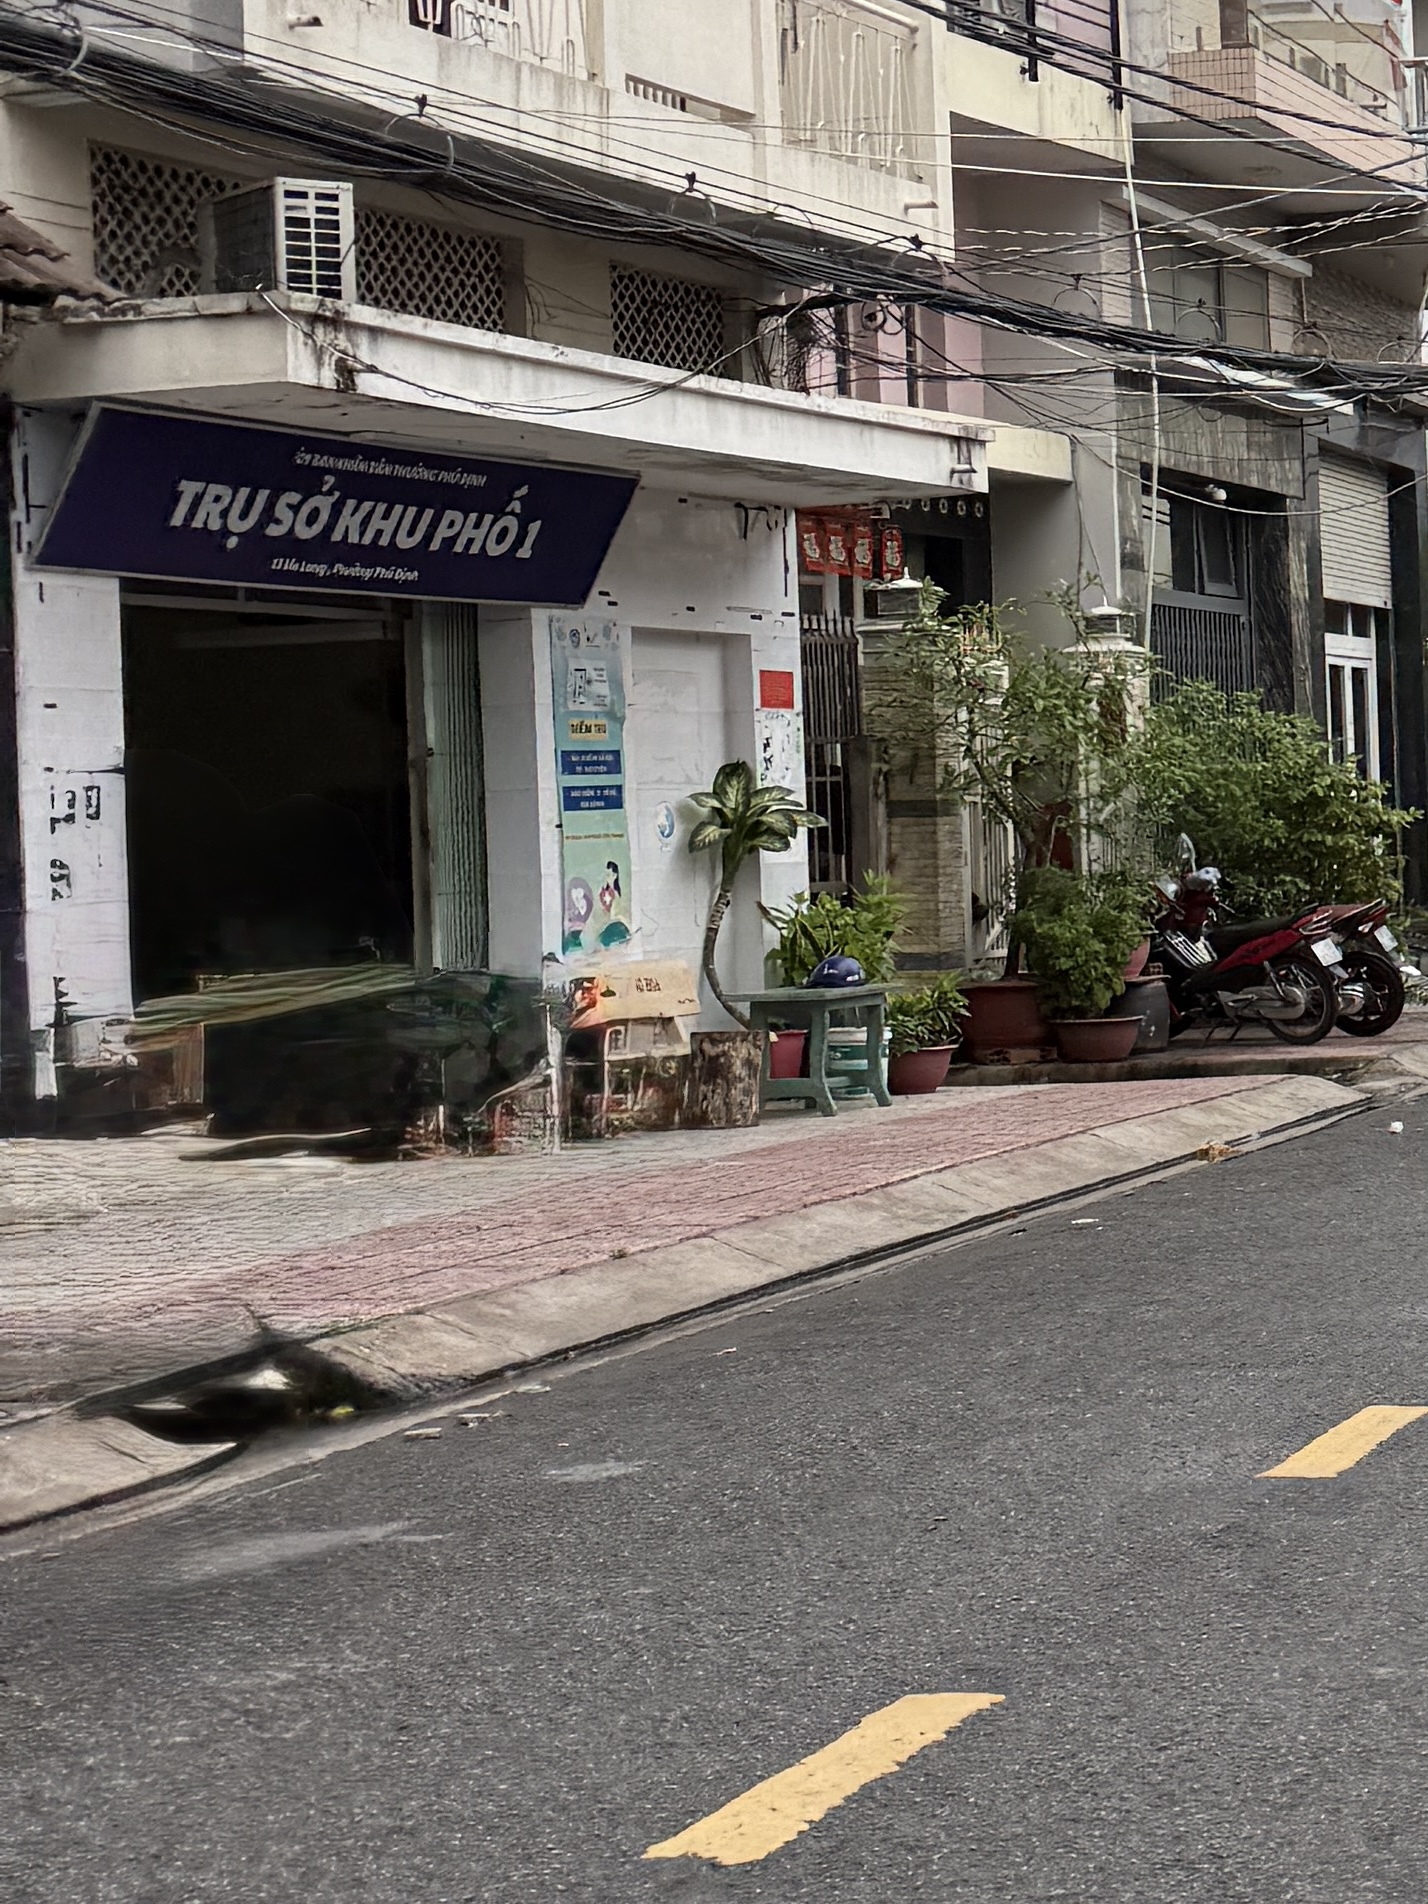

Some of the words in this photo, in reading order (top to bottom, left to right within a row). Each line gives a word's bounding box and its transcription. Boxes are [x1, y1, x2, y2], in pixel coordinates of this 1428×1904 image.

[169, 478, 271, 551] TRỤ
[265, 474, 341, 541] SỞ
[331, 498, 435, 551] KHU
[428, 484, 530, 559] PHỐ
[515, 518, 542, 559] 1
